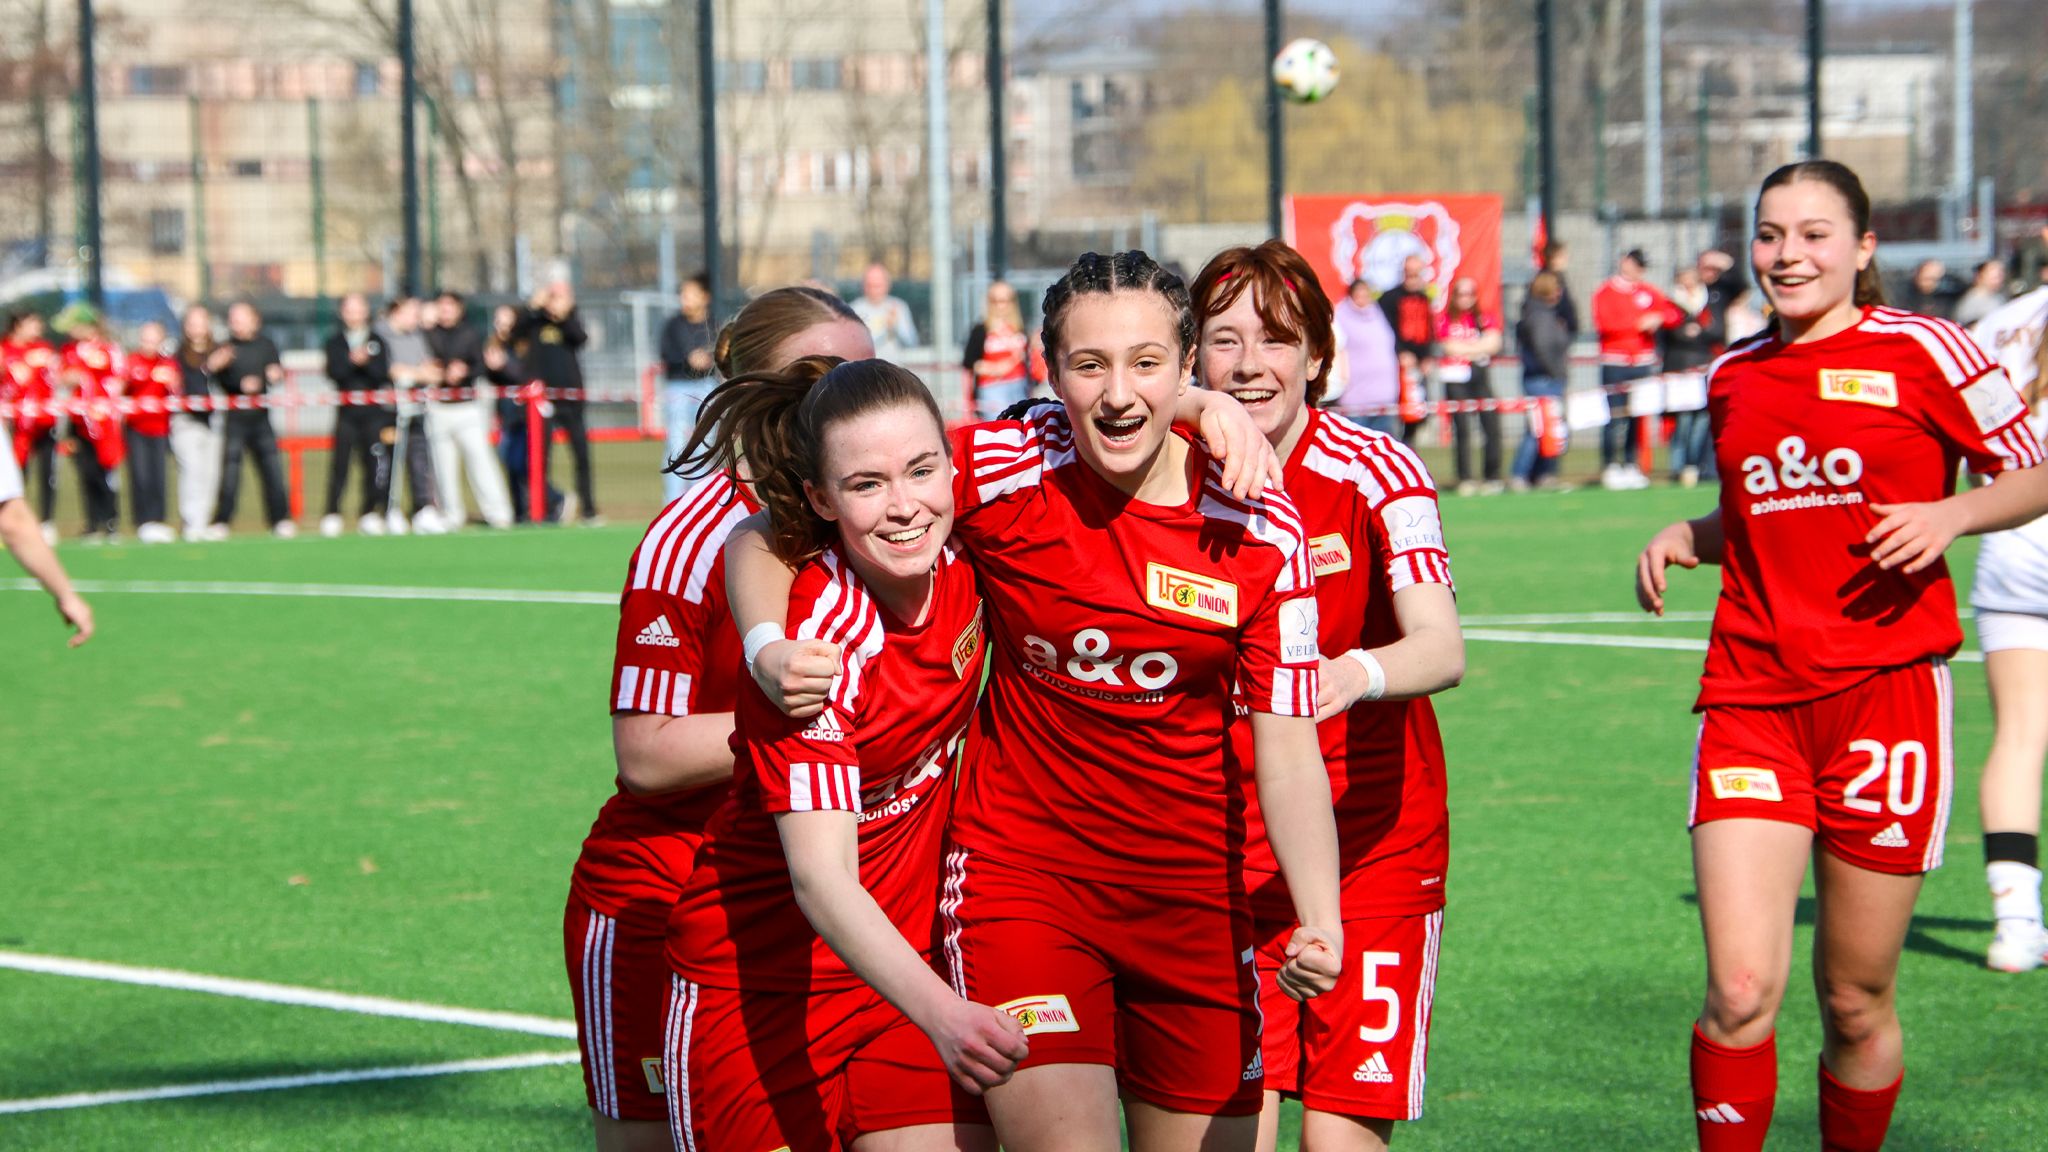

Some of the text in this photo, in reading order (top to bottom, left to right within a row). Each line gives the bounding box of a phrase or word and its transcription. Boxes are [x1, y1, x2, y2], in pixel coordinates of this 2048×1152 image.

[1742, 435, 1863, 495] a&o
[1750, 491, 1863, 515] aohostels.com
[1312, 549, 1345, 568] UNION
[1198, 592, 1230, 615] UNION
[635, 632, 681, 647] adidas
[1023, 628, 1178, 690] a&o
[801, 728, 845, 742] adidas
[1843, 738, 1928, 817] 20
[1359, 951, 1401, 1043] 5
[1036, 1010, 1068, 1024] UNION
[1353, 1069, 1394, 1083] adidas
